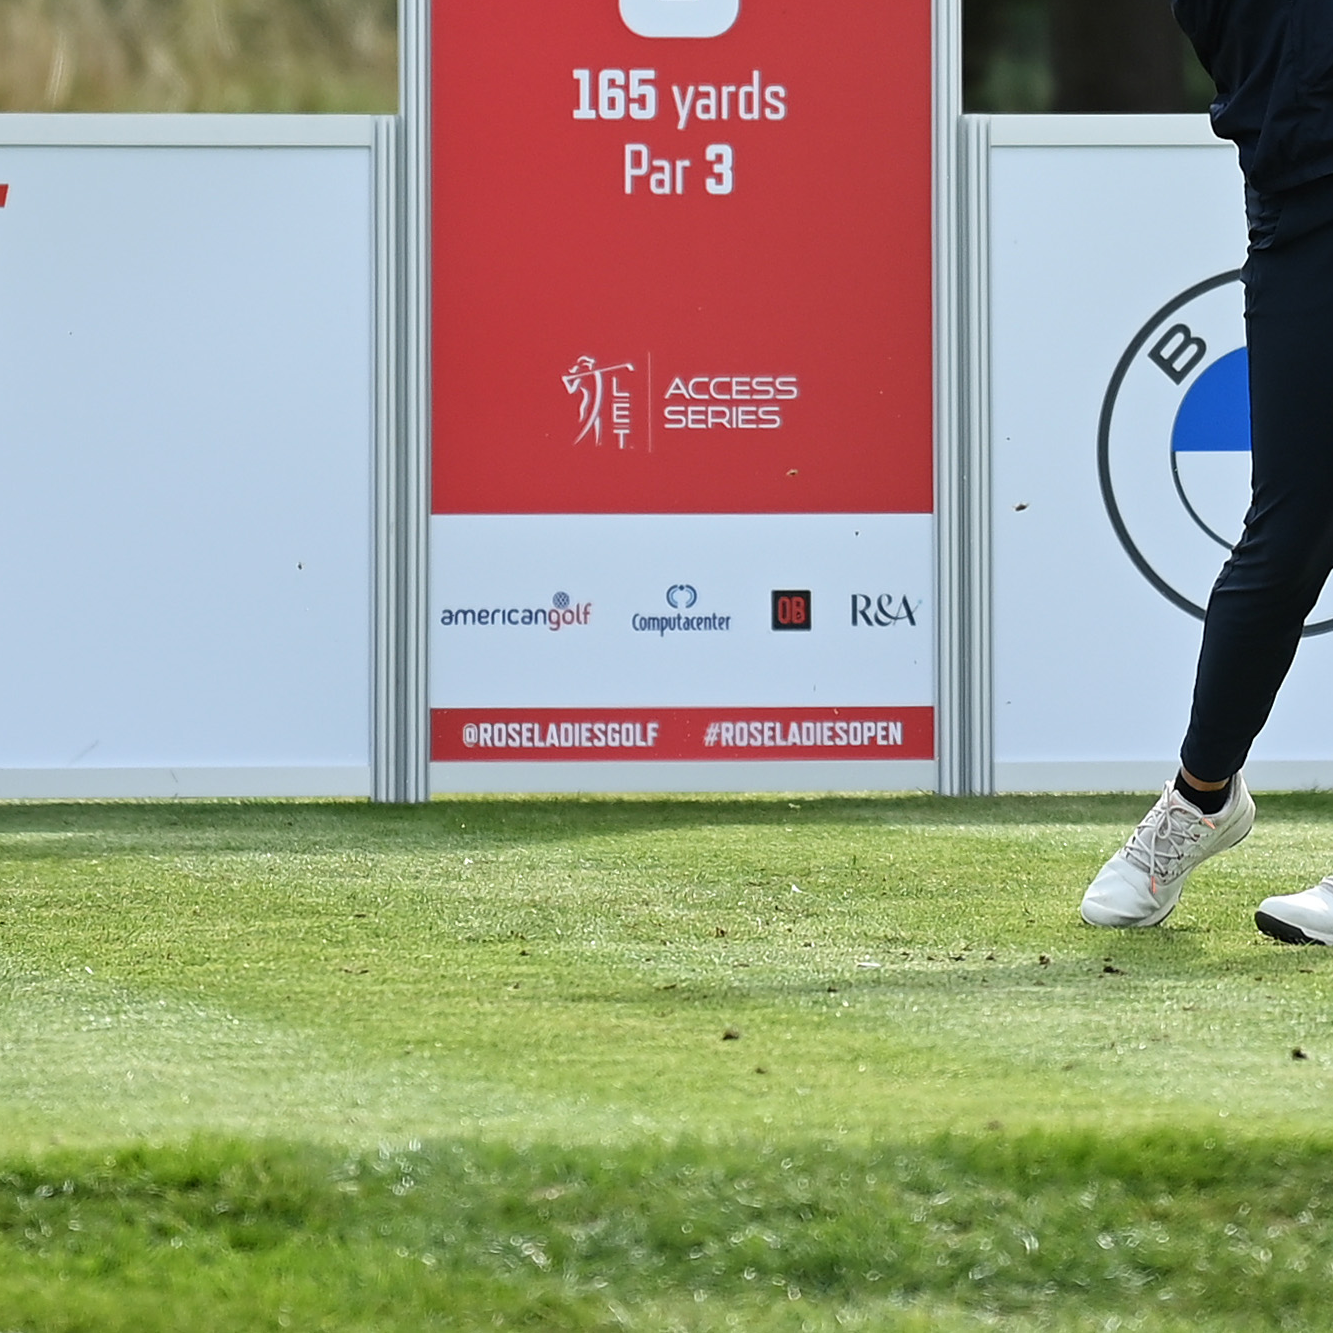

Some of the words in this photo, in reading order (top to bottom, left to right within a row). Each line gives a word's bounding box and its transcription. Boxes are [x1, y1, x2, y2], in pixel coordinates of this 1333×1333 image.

[572, 68, 657, 120] 165
[671, 69, 786, 130] yards
[624, 143, 690, 195] Par
[705, 143, 734, 195] 3
[664, 376, 798, 400] ACCESS
[664, 406, 782, 429] SERIES
[440, 602, 592, 632] americangolf
[851, 593, 919, 627] R&A
[632, 612, 731, 638] Computacenter
[462, 722, 659, 747] @ROSELADIESGOLF
[704, 721, 903, 747] #ROSELADIESOPEN
